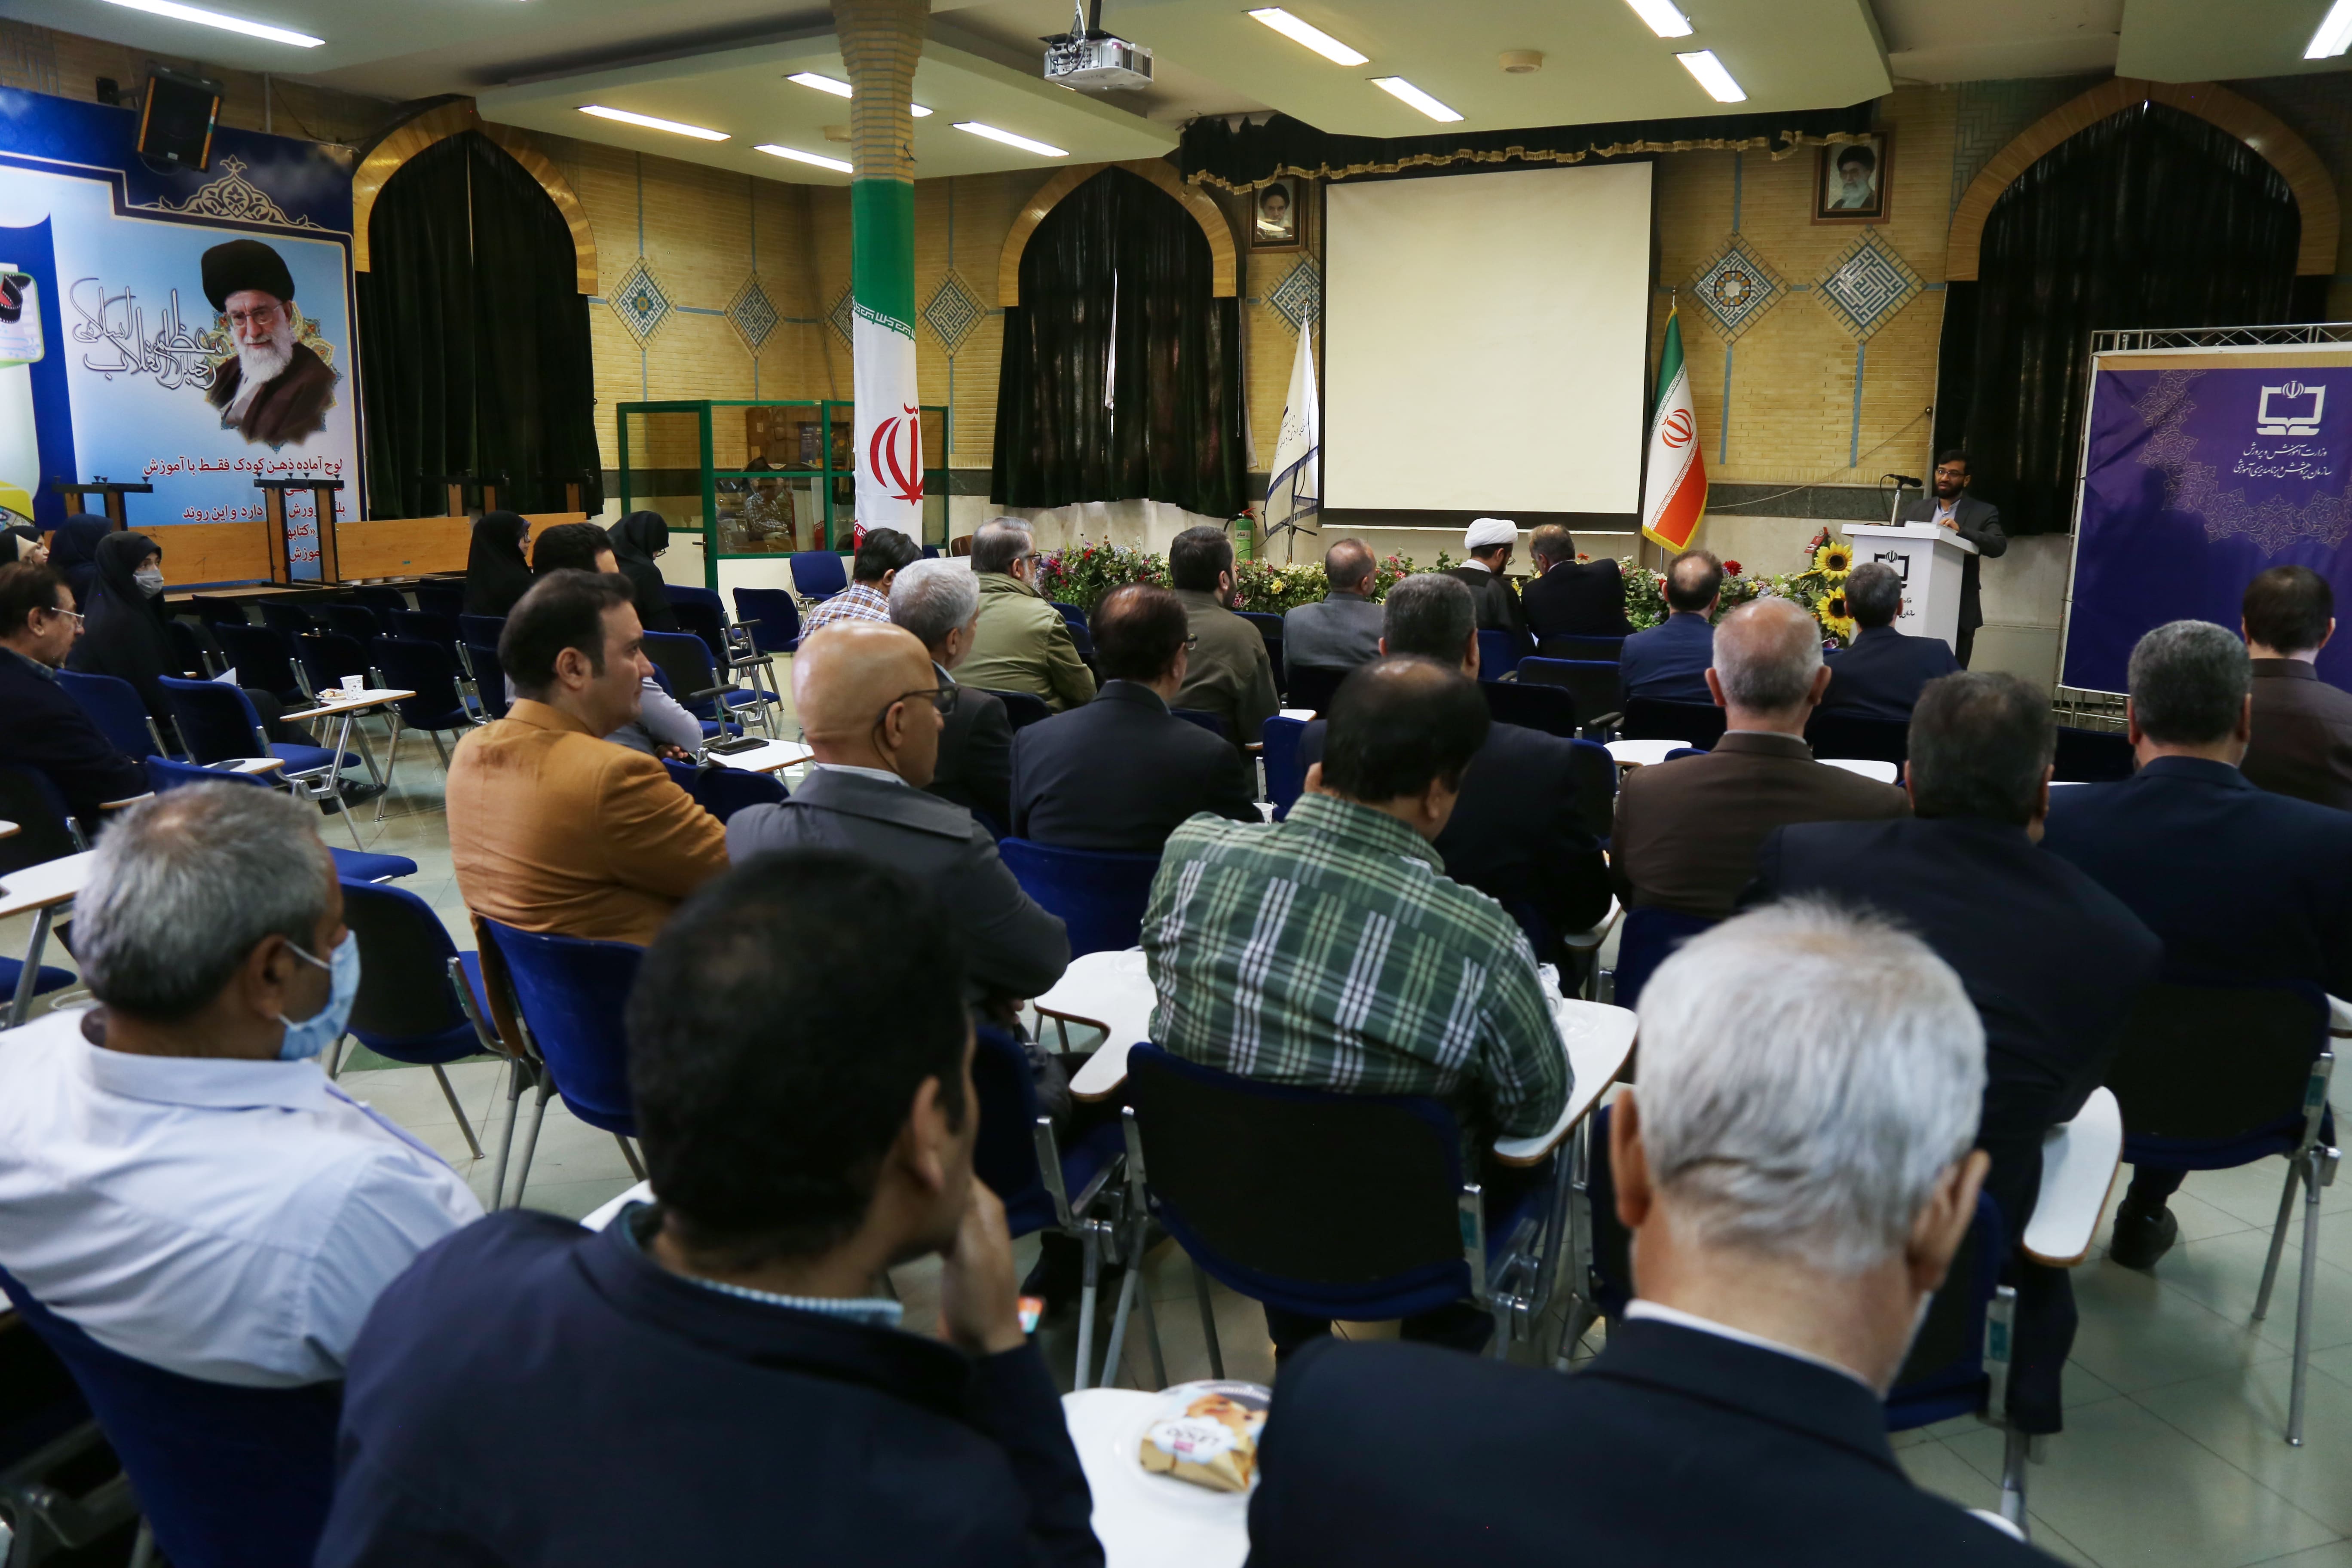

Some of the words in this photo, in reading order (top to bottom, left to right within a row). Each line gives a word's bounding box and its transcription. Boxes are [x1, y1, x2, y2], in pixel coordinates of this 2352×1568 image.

[2243, 441, 2264, 459] پرورش
[2266, 443, 2308, 460] آموزش
[2301, 447, 2328, 456] وزارت
[143, 456, 185, 476] آموزش
[187, 458, 196, 475] با
[198, 457, 230, 472] فقط
[233, 457, 265, 474] کودک
[266, 457, 294, 474] ذهن
[297, 456, 322, 470] آماده
[324, 458, 343, 475] لوح
[2233, 458, 2256, 474] آموزشی
[2277, 461, 2312, 480] پژوهش
[2306, 466, 2332, 479] سازمان
[182, 506, 210, 522] روند
[211, 504, 228, 521] این
[230, 508, 237, 520] و
[241, 504, 263, 519] دارد
